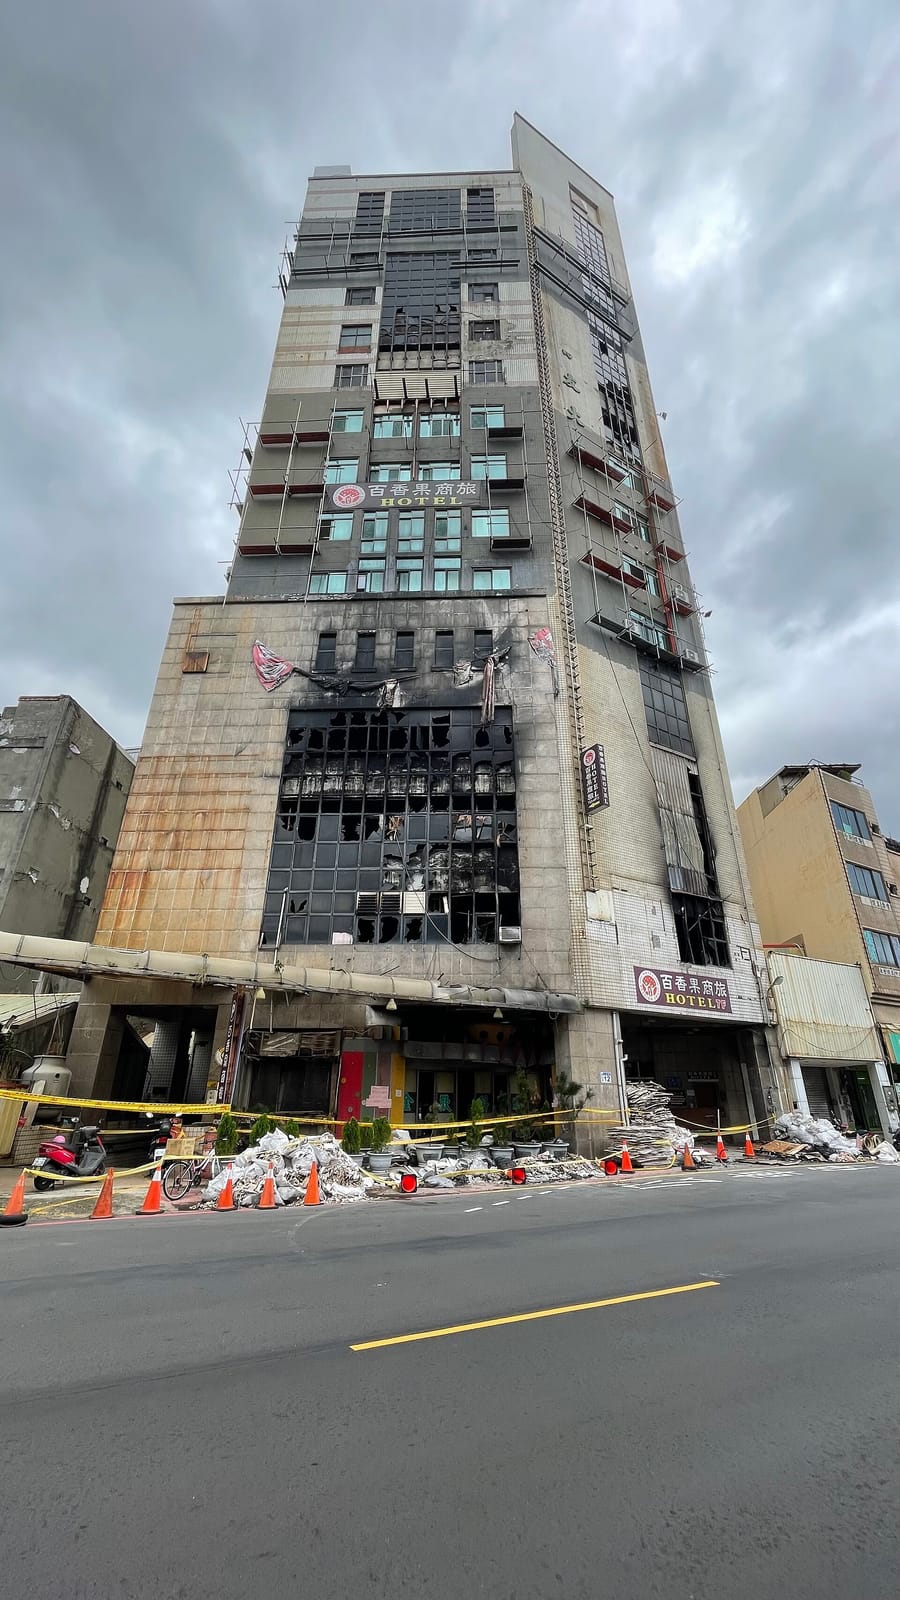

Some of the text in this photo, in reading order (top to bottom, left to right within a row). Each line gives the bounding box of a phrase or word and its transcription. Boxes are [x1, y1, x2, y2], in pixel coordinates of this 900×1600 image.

[367, 482, 477, 497] 百香果商旅
[379, 496, 463, 507] HOTEL
[591, 763, 599, 798] HOTEL
[659, 974, 728, 998] 百香果商旅
[665, 992, 716, 1009] HOTEL
